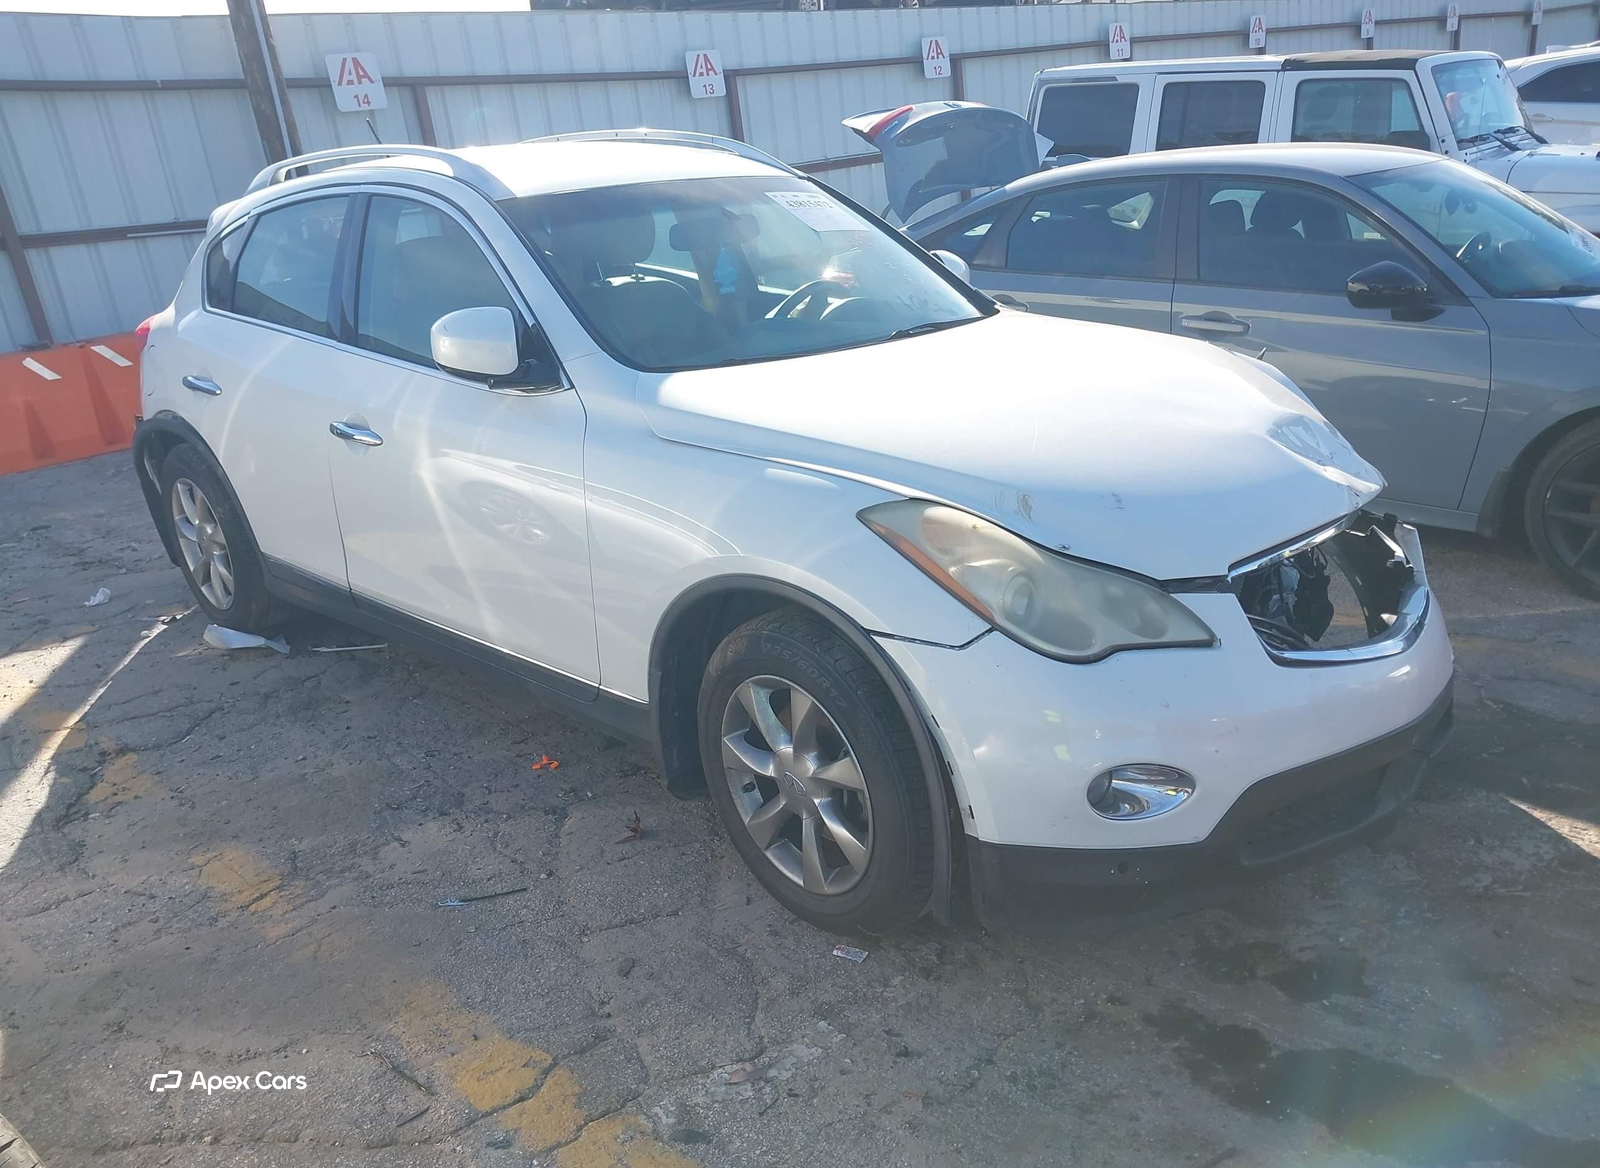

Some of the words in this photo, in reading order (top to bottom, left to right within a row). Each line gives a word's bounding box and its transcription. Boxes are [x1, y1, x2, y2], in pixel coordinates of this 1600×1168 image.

[1117, 48, 1124, 57] 11
[933, 66, 943, 76] 12
[702, 84, 715, 95] 13
[353, 94, 371, 108] 14
